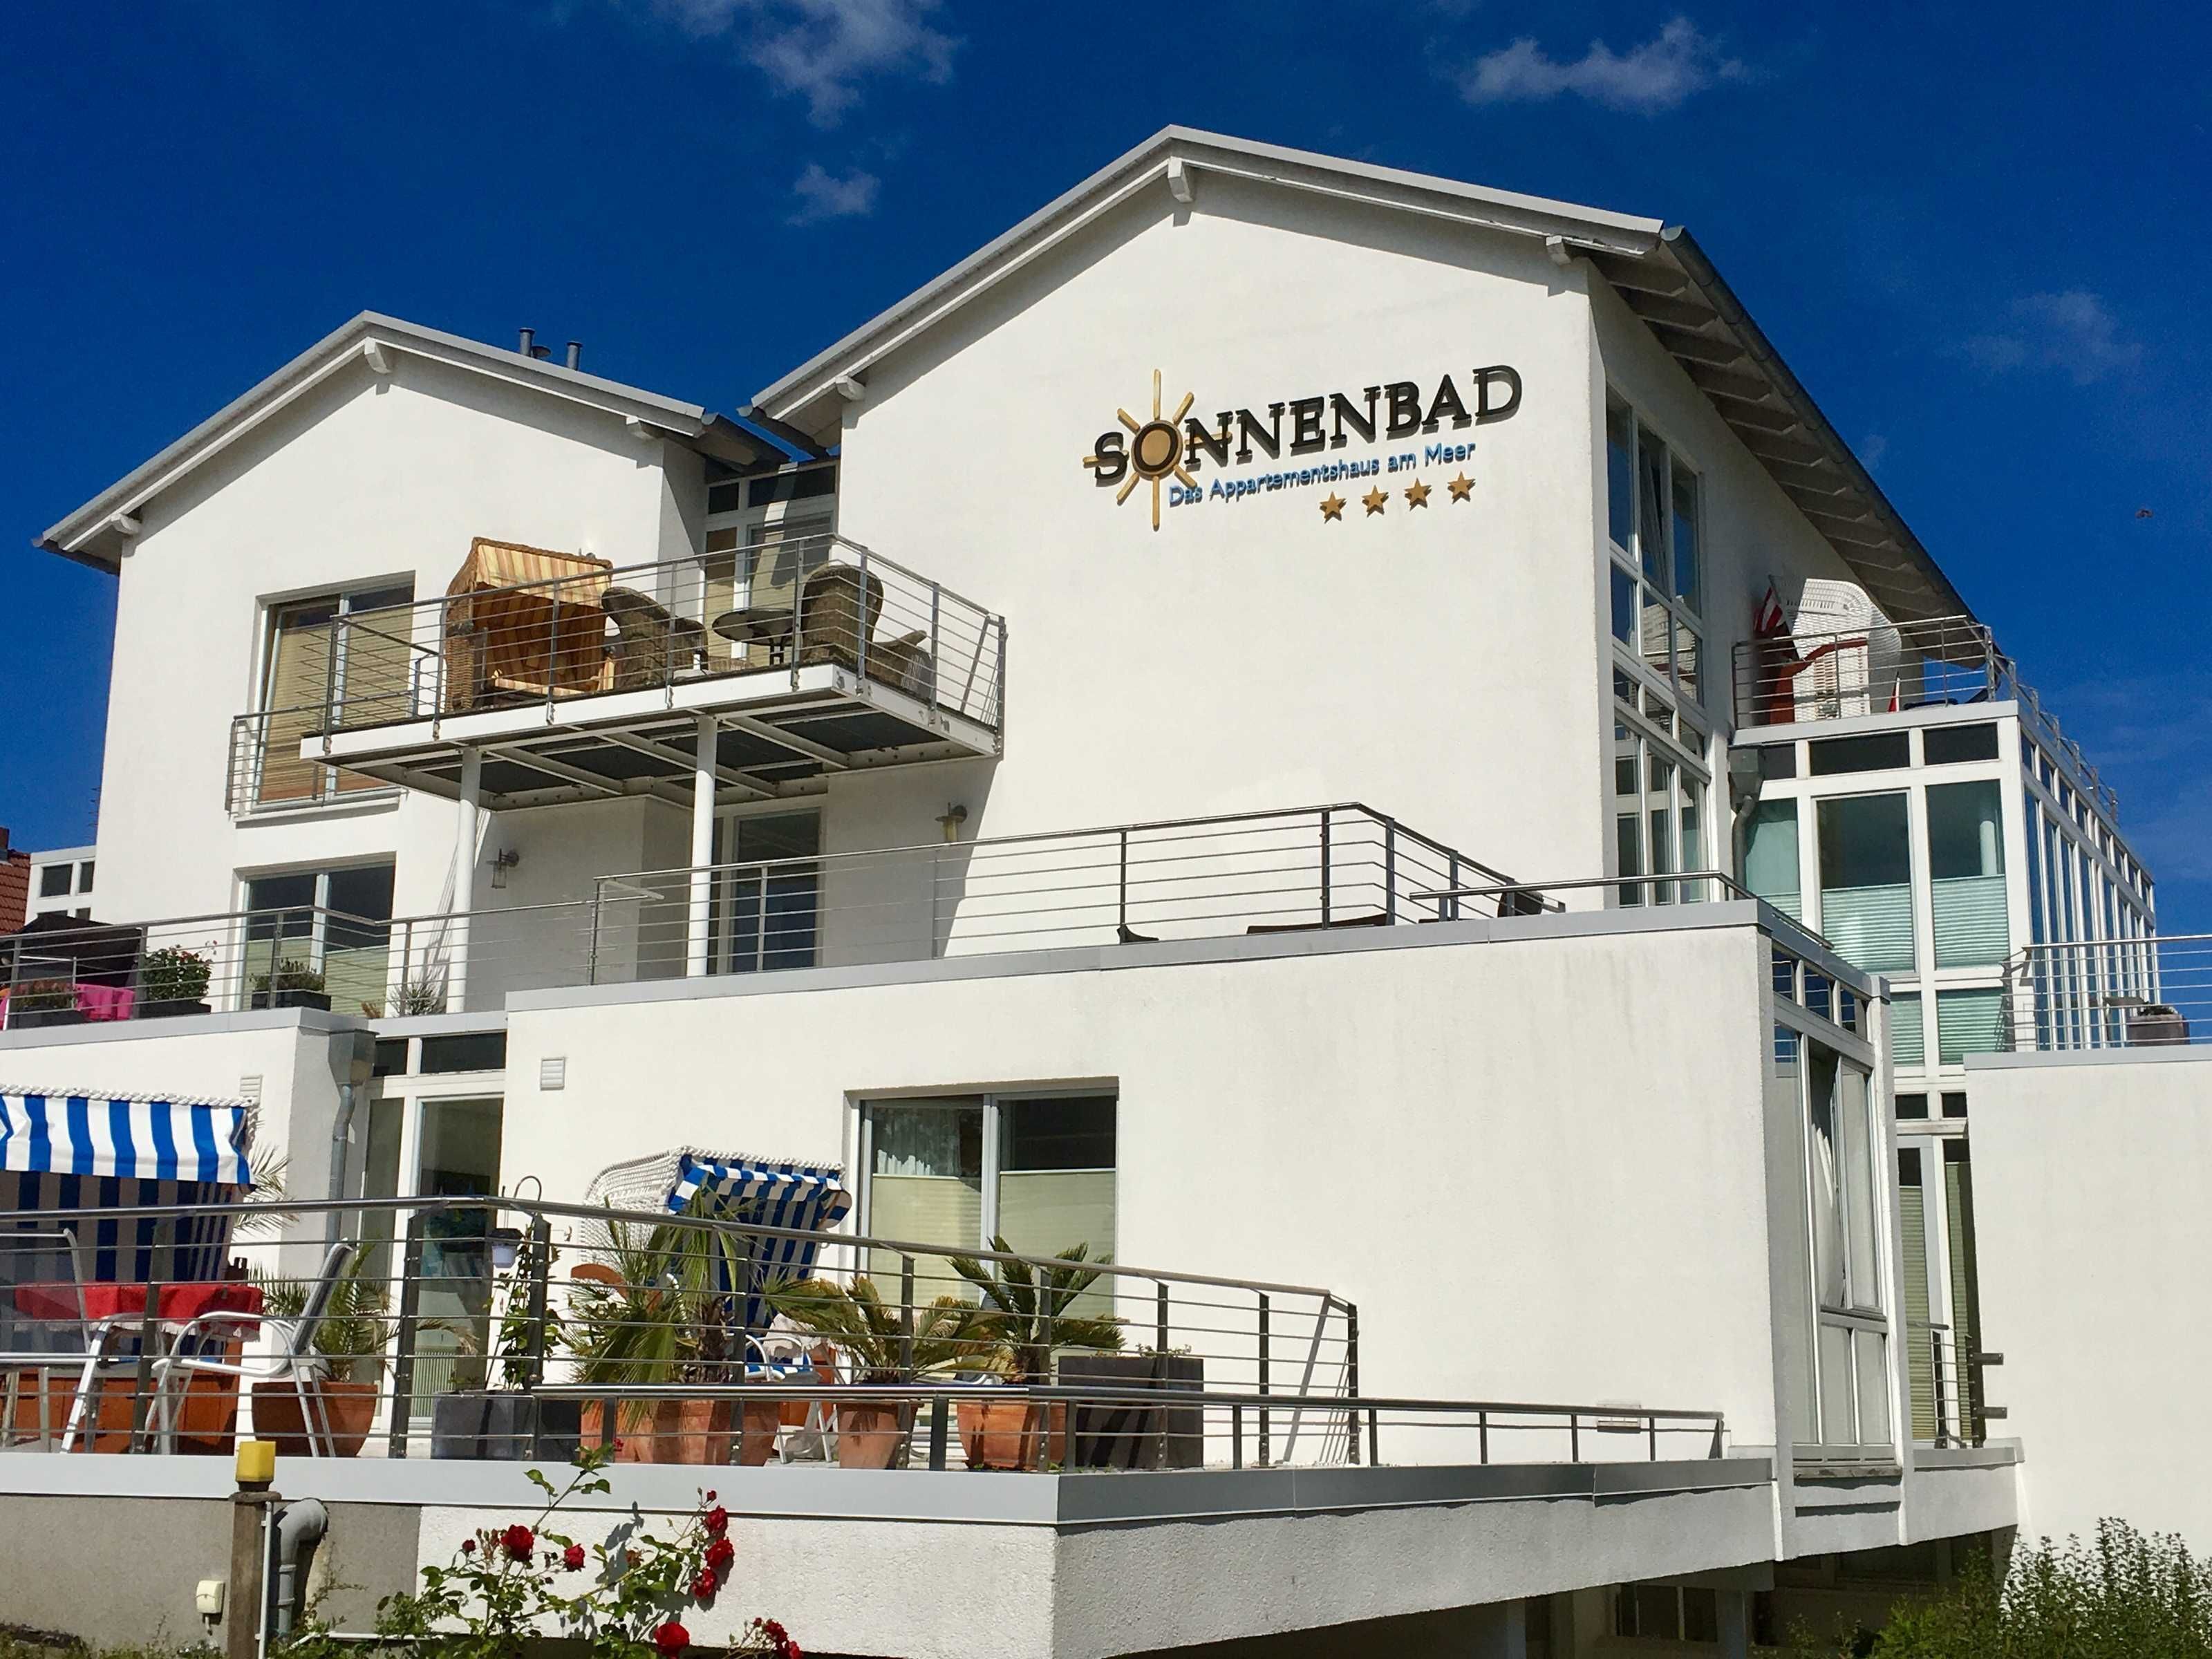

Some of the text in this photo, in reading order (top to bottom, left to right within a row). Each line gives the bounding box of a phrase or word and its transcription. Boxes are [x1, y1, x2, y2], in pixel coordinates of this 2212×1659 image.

[1094, 364, 1523, 481] SONNENBAD
[1169, 443, 1477, 506] Das Appartementshaus am Meer
